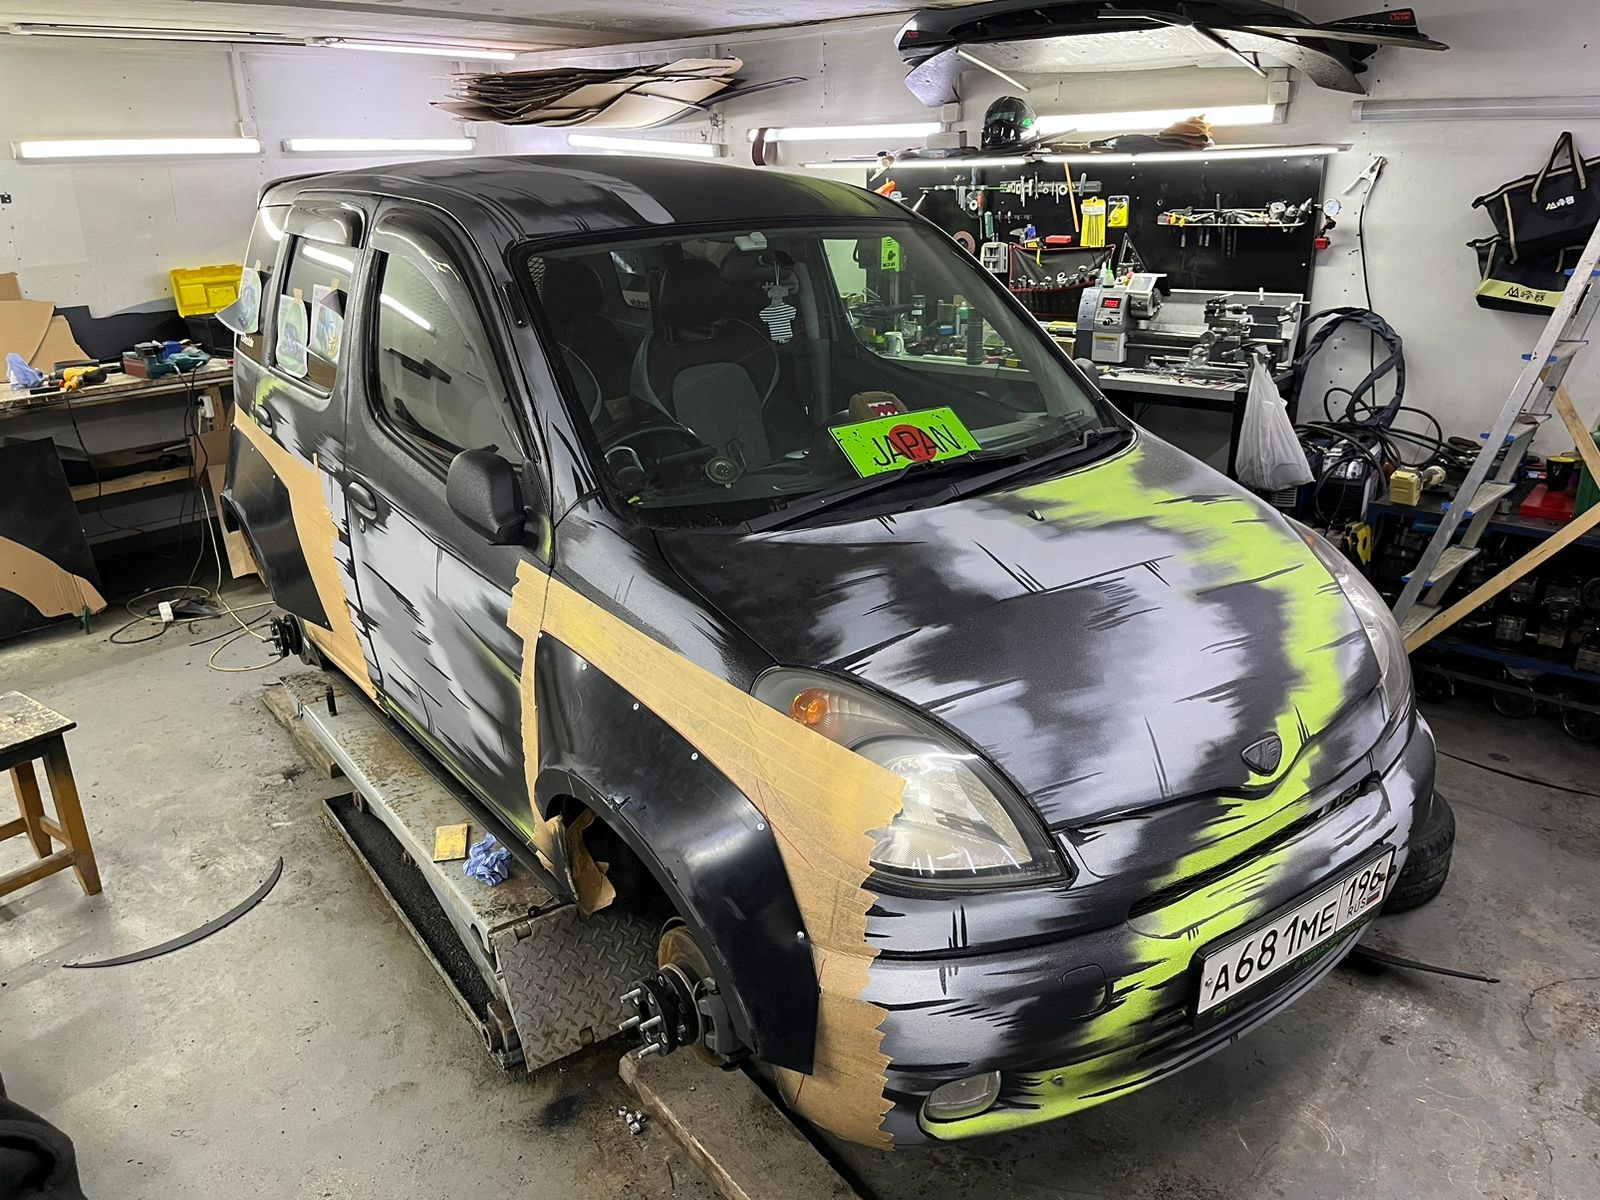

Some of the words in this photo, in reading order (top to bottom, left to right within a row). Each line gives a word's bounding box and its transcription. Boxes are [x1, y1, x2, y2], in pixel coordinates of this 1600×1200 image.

[872, 423, 962, 467] JAPAN
[1211, 900, 1337, 1000] A681ME
[1346, 861, 1381, 907] 196
[1346, 898, 1367, 919] RUS
